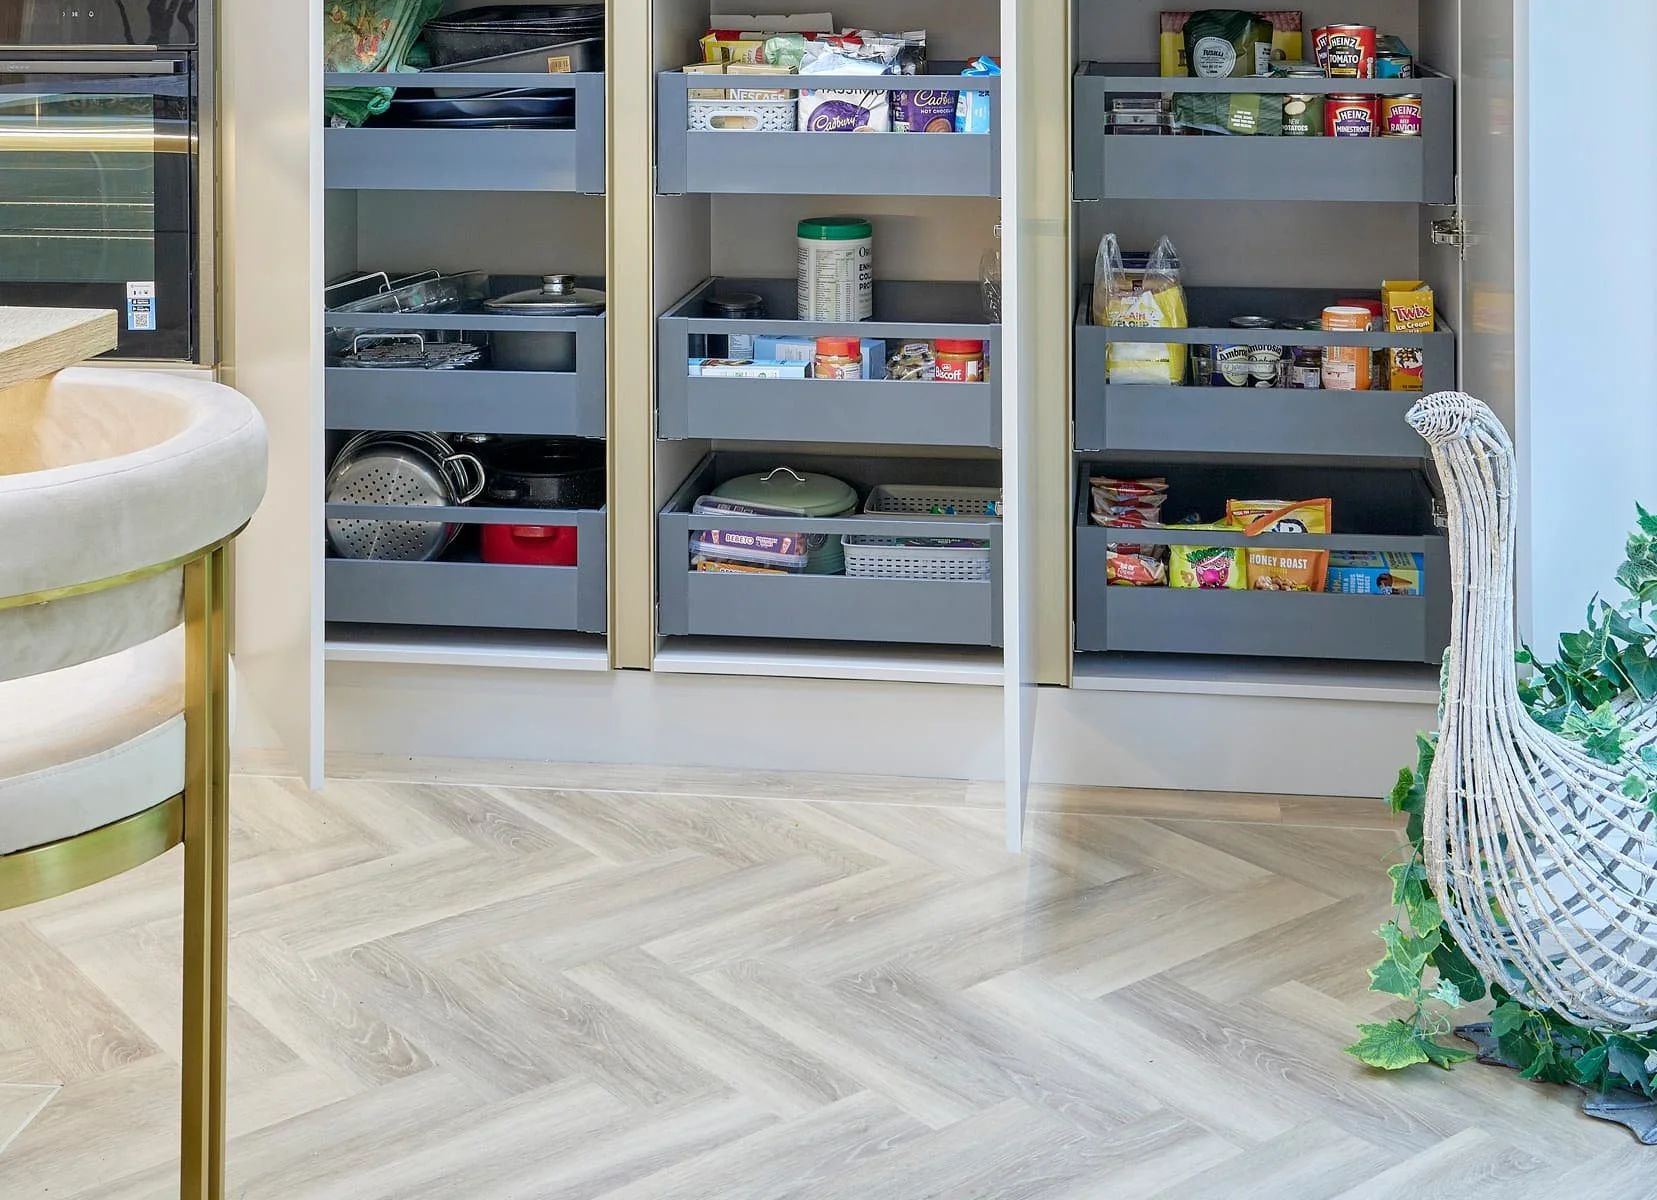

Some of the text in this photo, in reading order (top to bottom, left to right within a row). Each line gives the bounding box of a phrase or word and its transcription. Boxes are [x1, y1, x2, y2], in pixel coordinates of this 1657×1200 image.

[1331, 36, 1356, 48] HEINZ
[1329, 54, 1359, 64] TOMATO
[1340, 110, 1367, 121] HEINZ
[1391, 106, 1419, 116] HEINZ
[813, 114, 857, 132] Cadbury
[1390, 123, 1420, 133] RAVIOLI
[1336, 125, 1370, 133] MINESTRONE
[1391, 304, 1431, 321] Twix
[1406, 321, 1430, 329] Cream
[935, 366, 962, 380] Biscoff
[1250, 554, 1308, 569] HONEY ROAST
